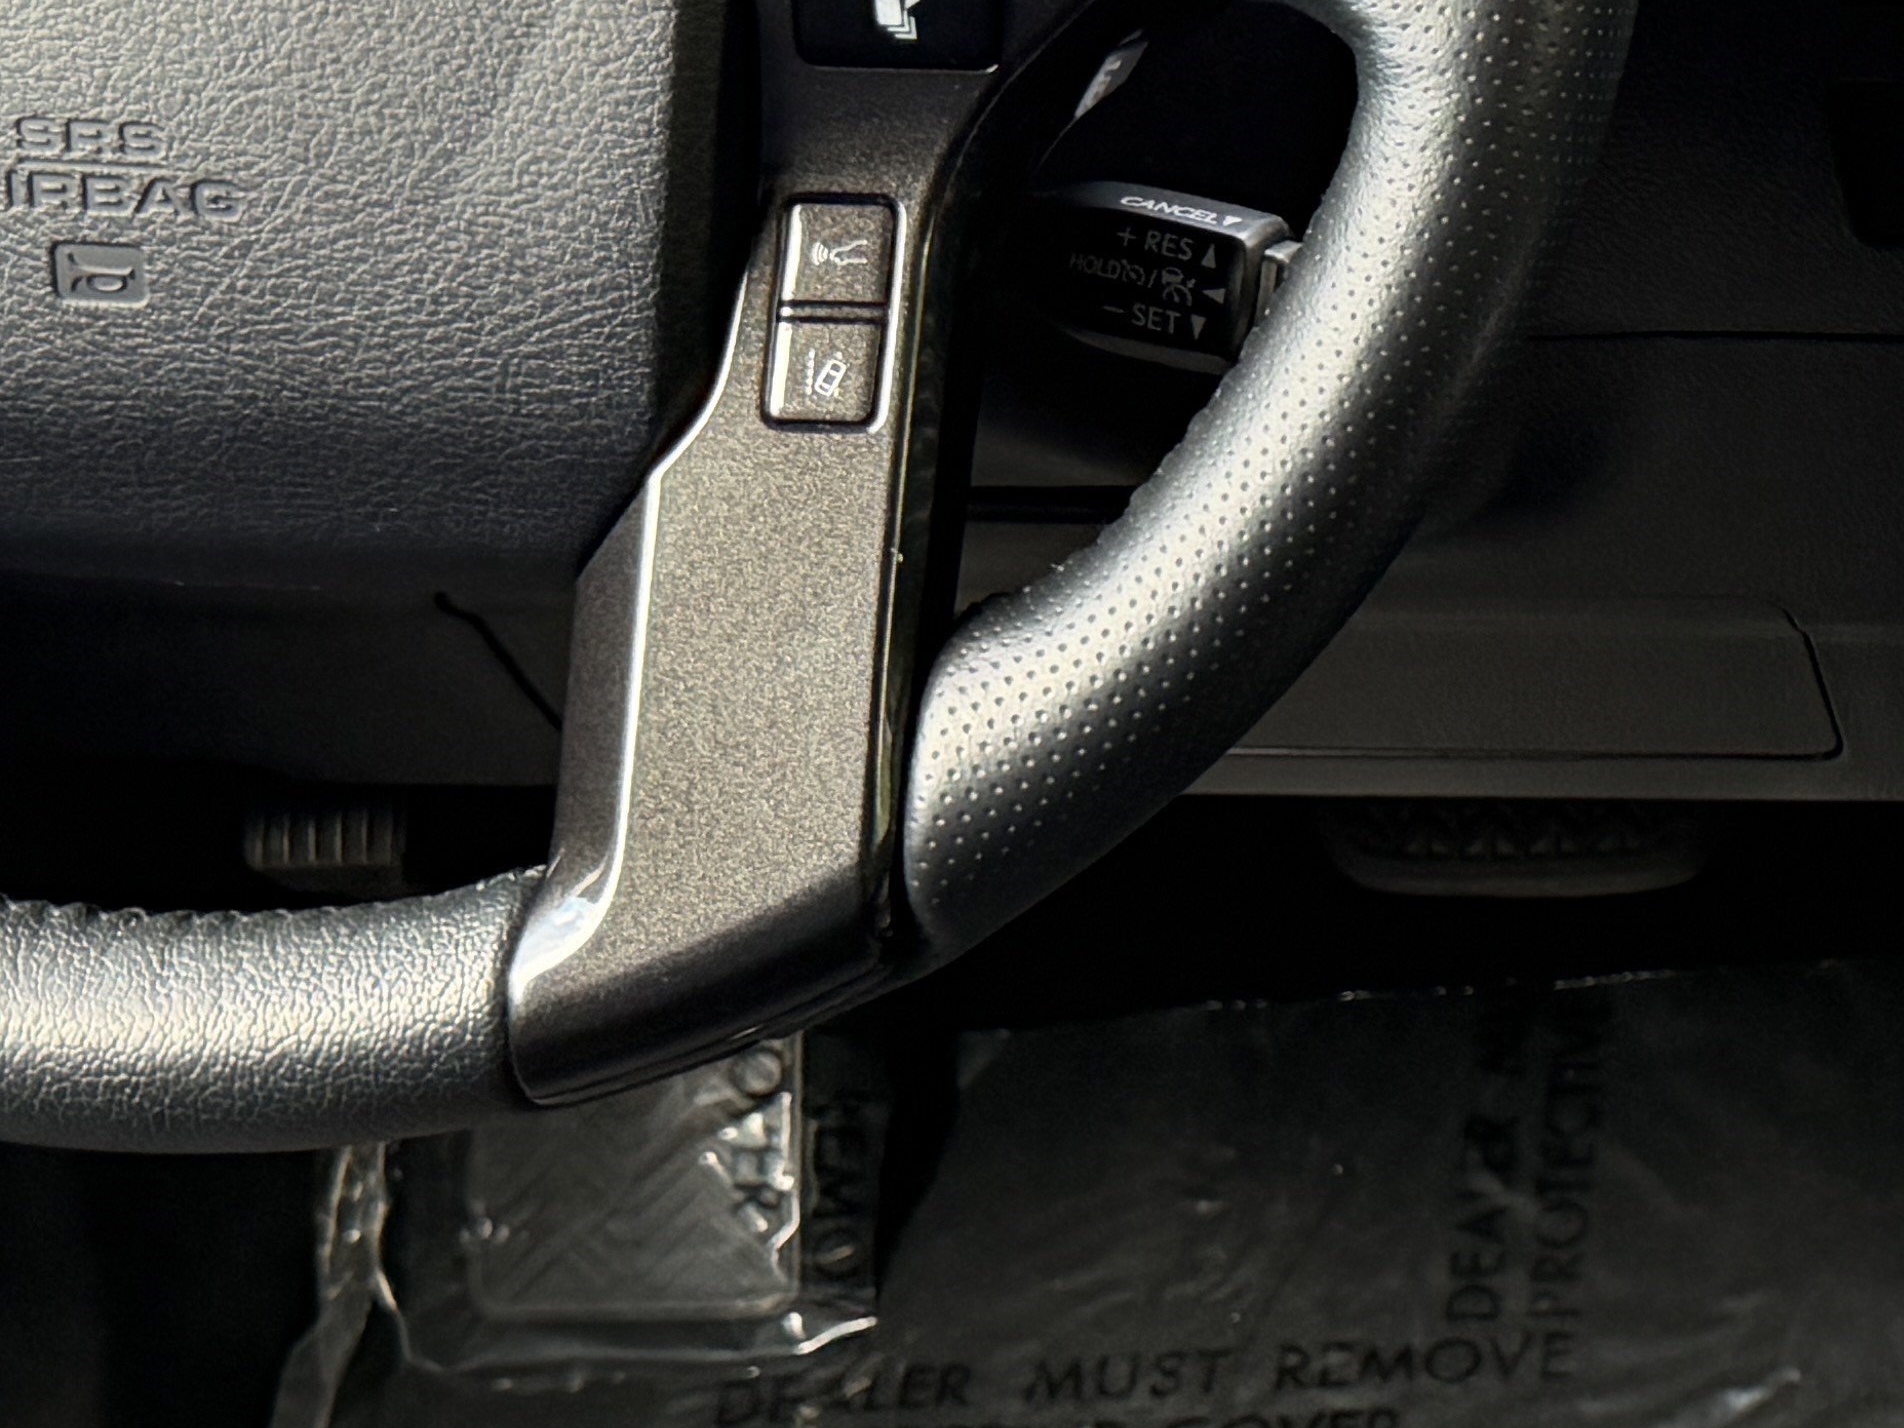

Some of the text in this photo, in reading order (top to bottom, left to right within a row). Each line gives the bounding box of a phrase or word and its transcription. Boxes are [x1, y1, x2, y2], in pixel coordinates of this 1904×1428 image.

[1119, 195, 1219, 225] CANCEL
[1144, 229, 1195, 261] RES
[1130, 302, 1182, 335] SET
[1021, 1348, 1235, 1405] MUST
[1271, 1331, 1576, 1393] REMOVE
